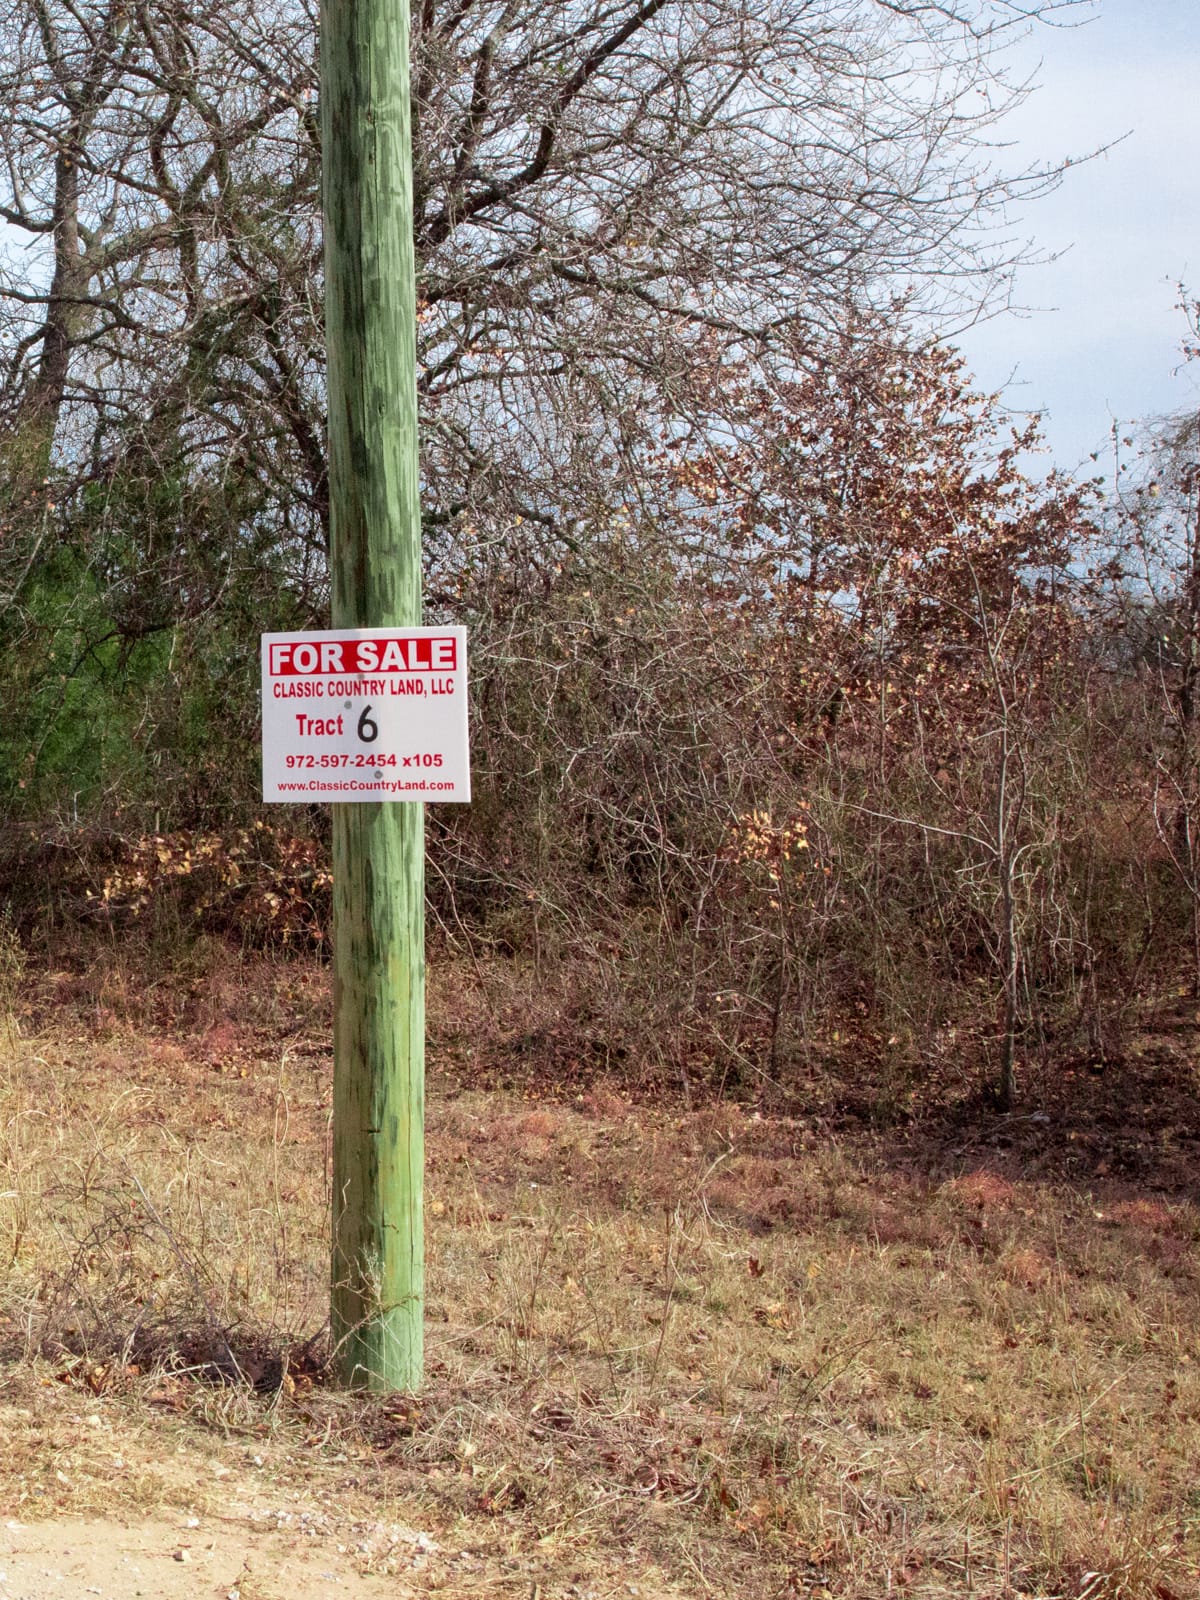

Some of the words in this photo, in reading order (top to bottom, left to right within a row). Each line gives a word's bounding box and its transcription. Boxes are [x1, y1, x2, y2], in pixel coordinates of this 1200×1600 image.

[271, 643, 345, 674] FOR
[356, 640, 454, 671] SALE
[273, 681, 324, 699] CLASSIC
[327, 679, 386, 697] COUNTRY
[390, 678, 427, 698] LAND,
[431, 678, 454, 695] LLC
[295, 713, 344, 736] Tract
[357, 704, 378, 743] 6
[285, 753, 397, 768] 972-597-2454
[402, 753, 443, 767] x105
[277, 780, 455, 793] www.ClassicCountryLand.com
